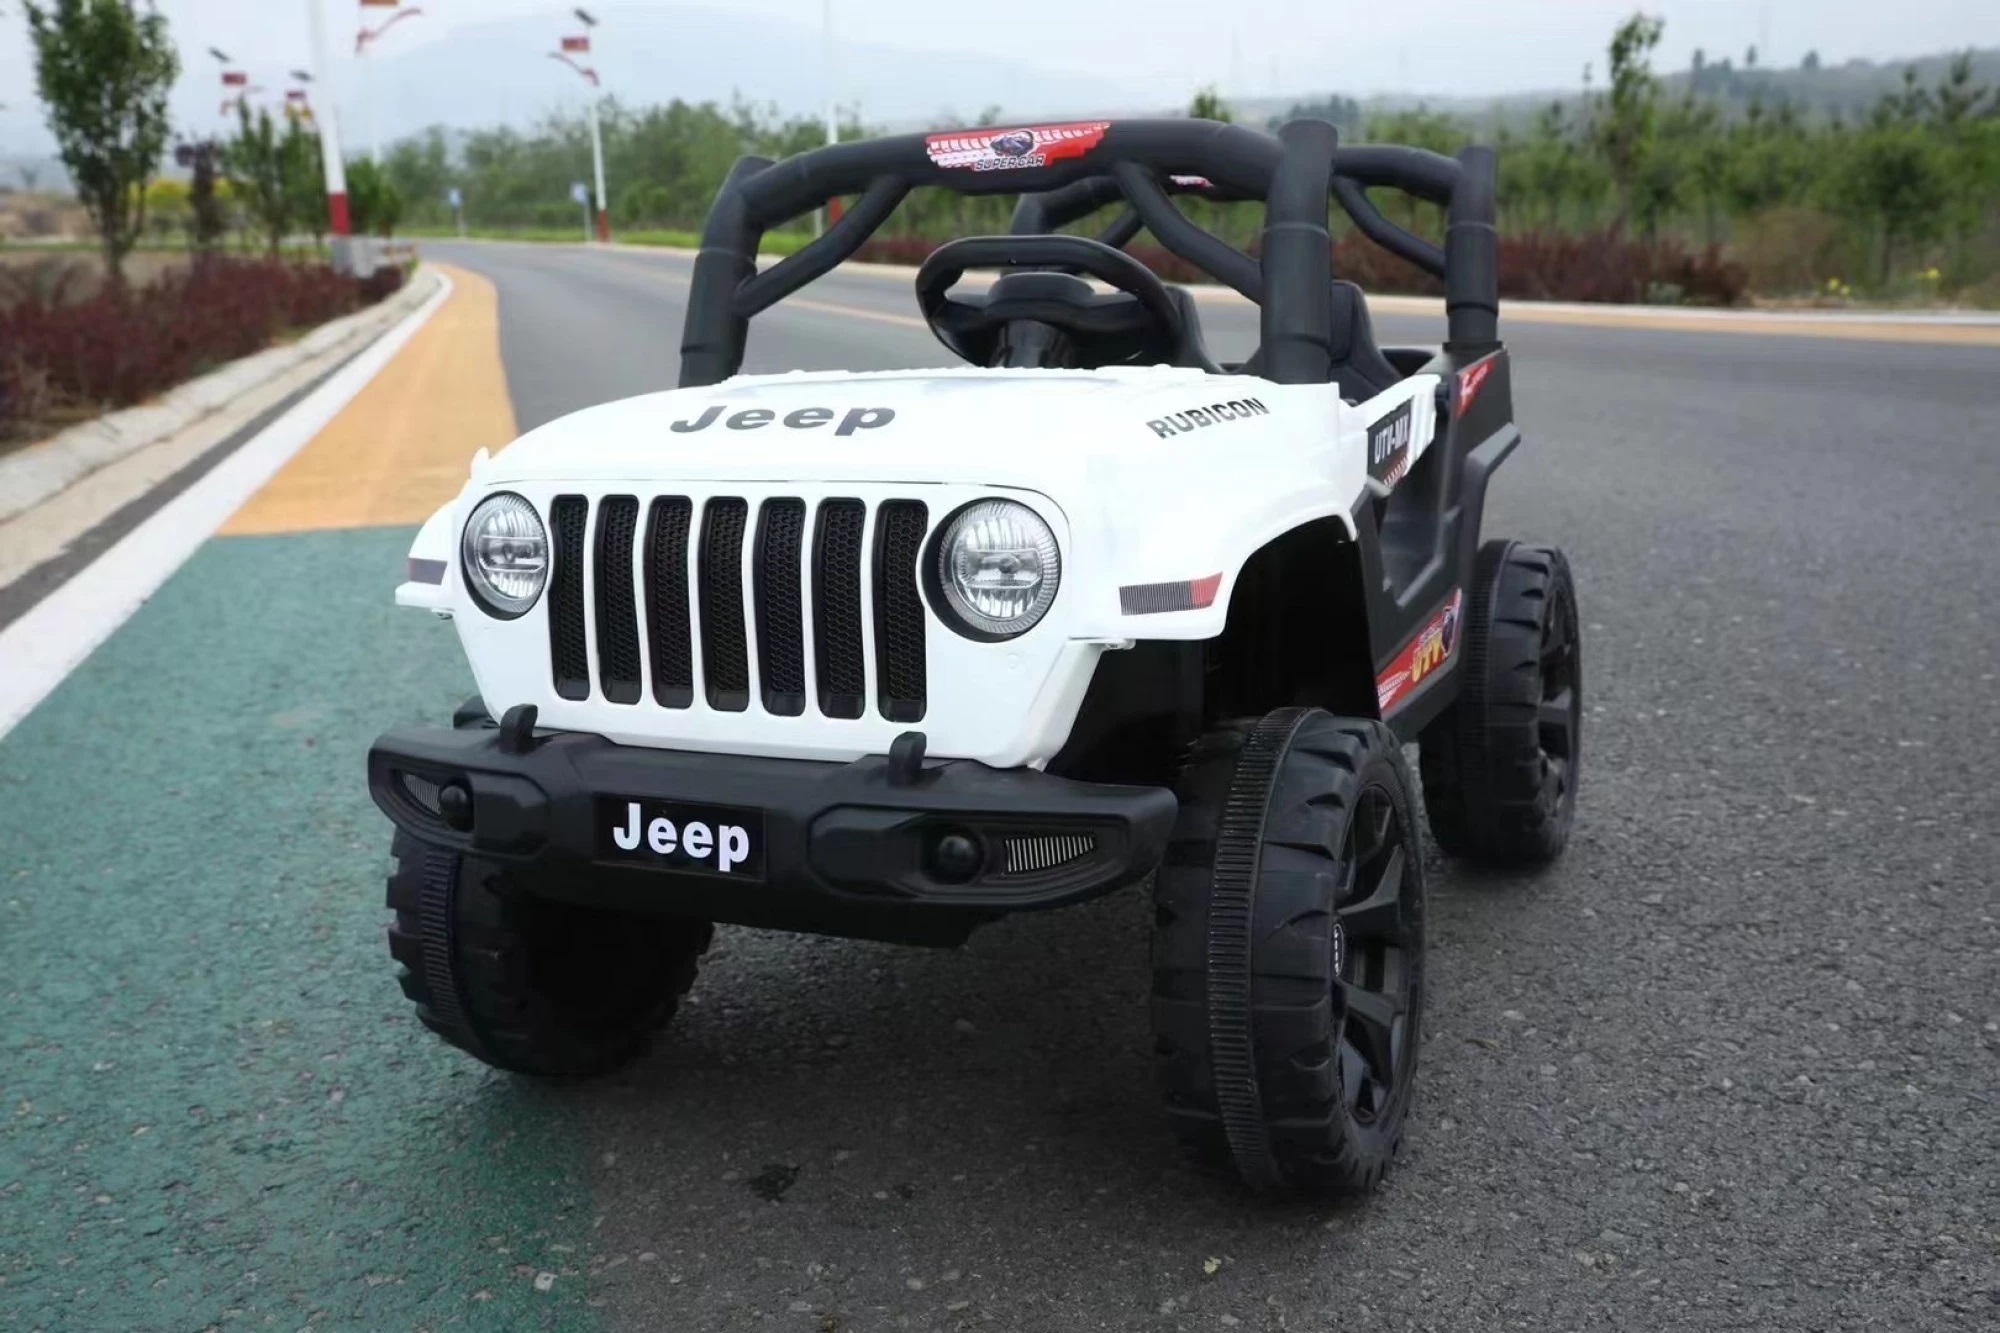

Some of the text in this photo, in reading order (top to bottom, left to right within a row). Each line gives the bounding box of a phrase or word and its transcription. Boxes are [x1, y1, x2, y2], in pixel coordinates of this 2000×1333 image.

[669, 405, 896, 437] Jeep
[1145, 397, 1270, 439] RUBICON
[613, 802, 749, 872] Jeep
